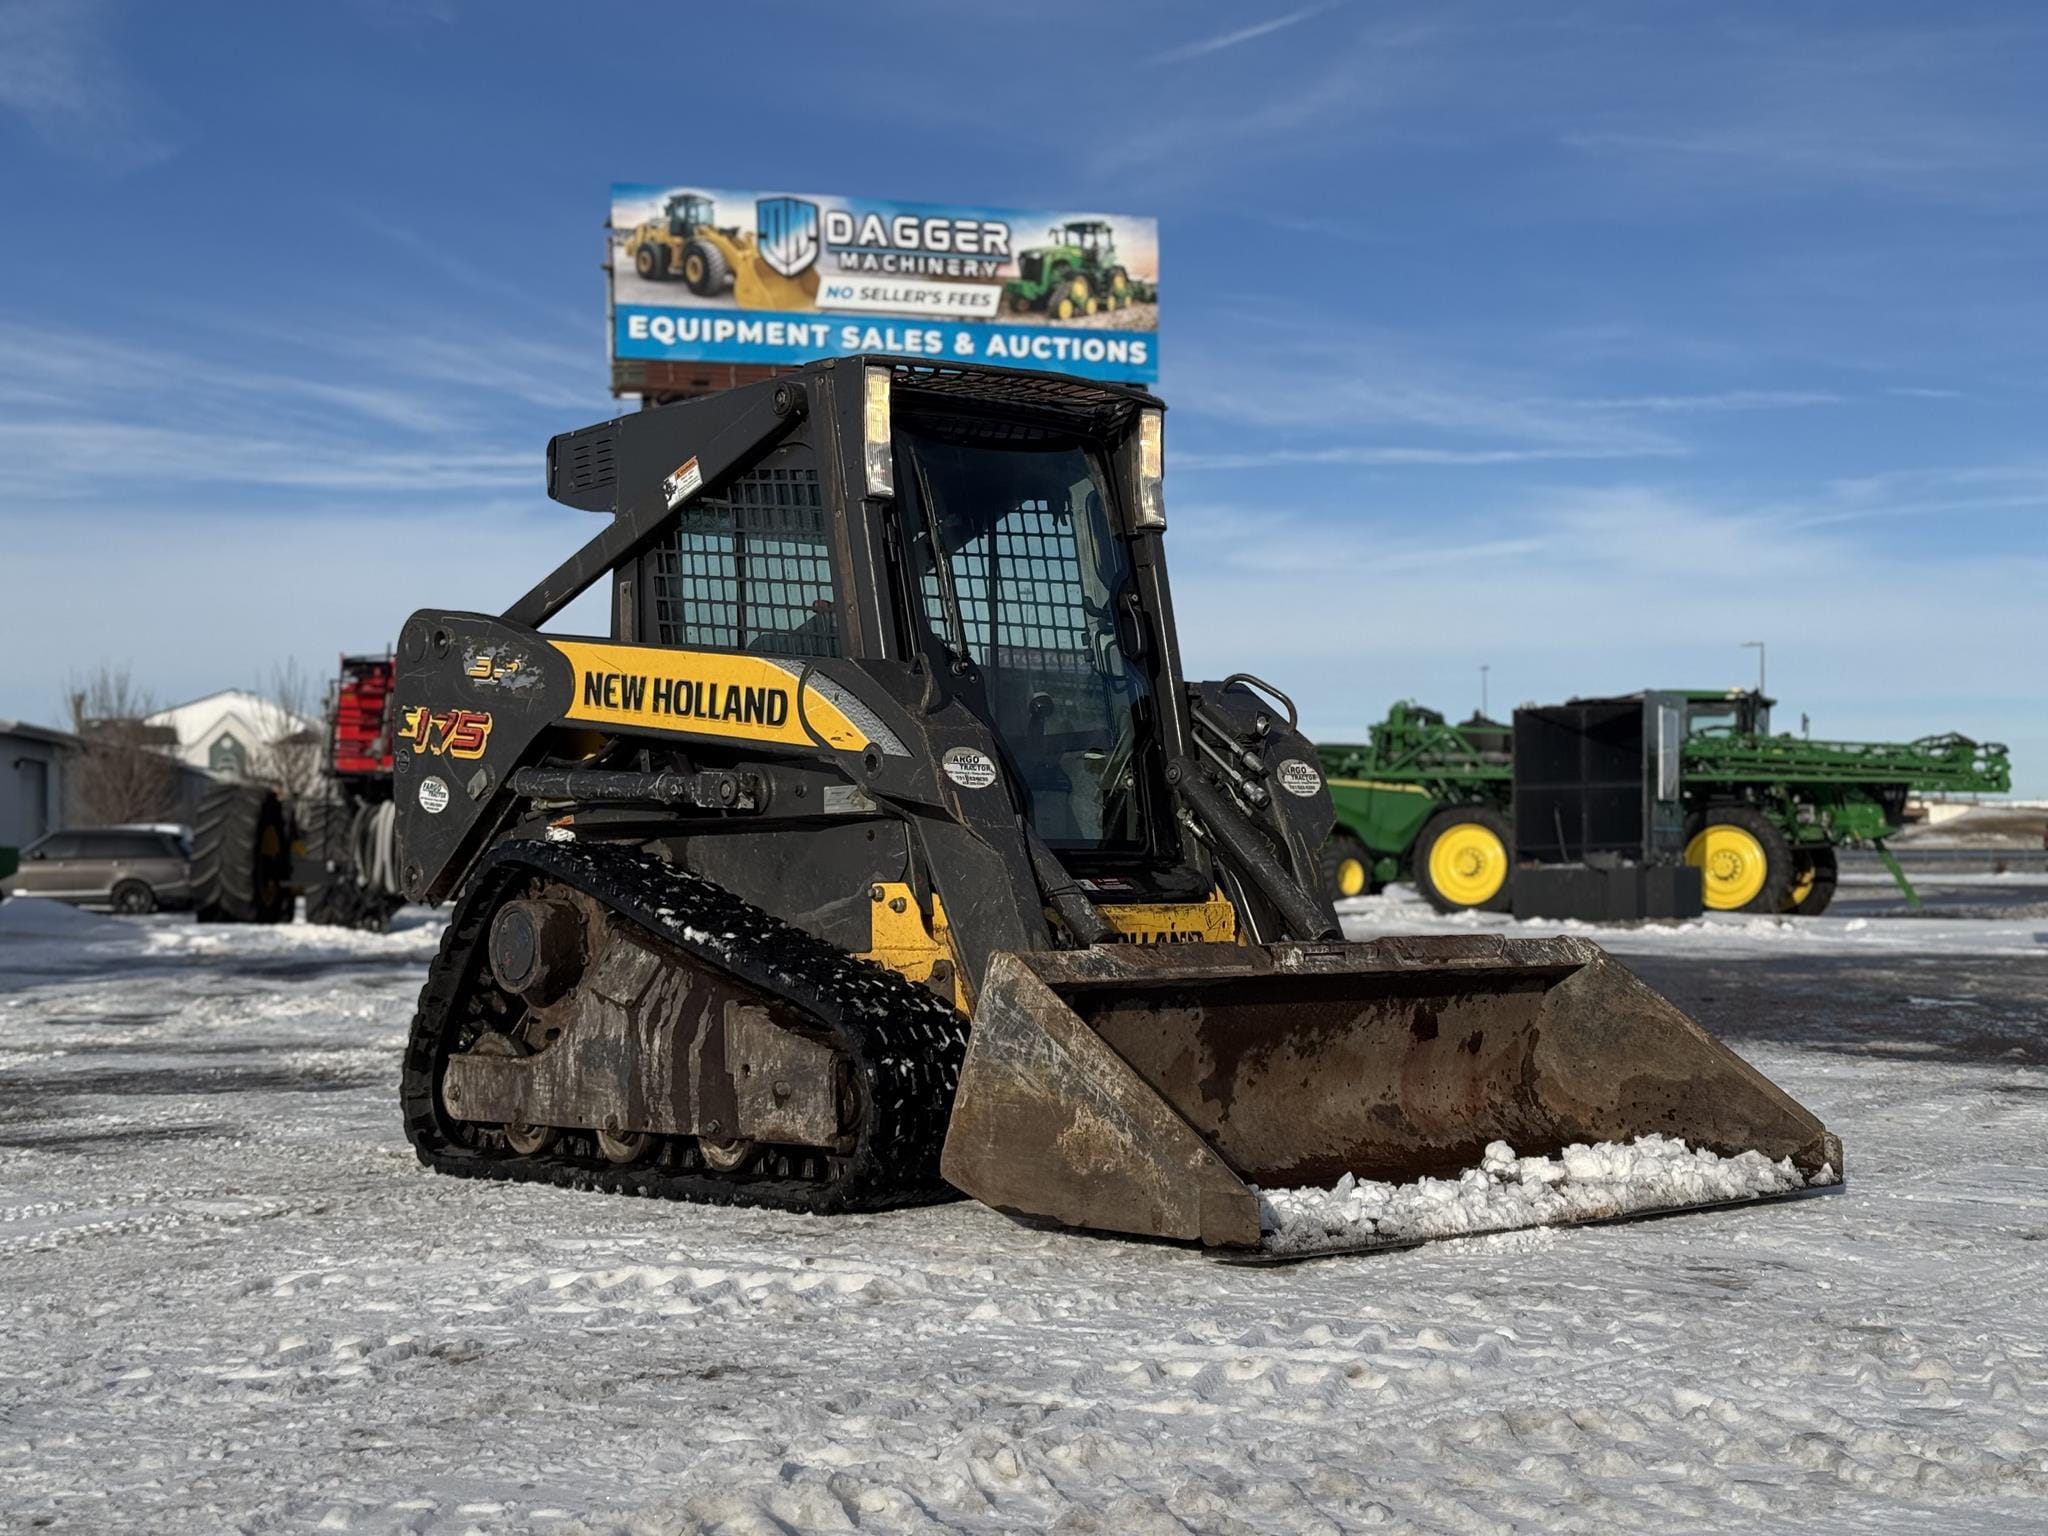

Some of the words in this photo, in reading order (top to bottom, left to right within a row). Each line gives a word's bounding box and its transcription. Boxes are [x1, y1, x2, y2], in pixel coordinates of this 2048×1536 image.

[826, 211, 1009, 254] DAGGER
[840, 252, 998, 277] MACHINERY
[826, 285, 853, 299] NO
[860, 287, 942, 304] SELLER'S
[948, 291, 992, 307] FEES
[628, 315, 830, 347] EQUIPMENT
[841, 326, 943, 353] SALES
[953, 332, 975, 355] &
[985, 334, 1148, 364] AUCTIONS
[584, 671, 647, 711] NEW
[652, 677, 788, 727] HOLLAND
